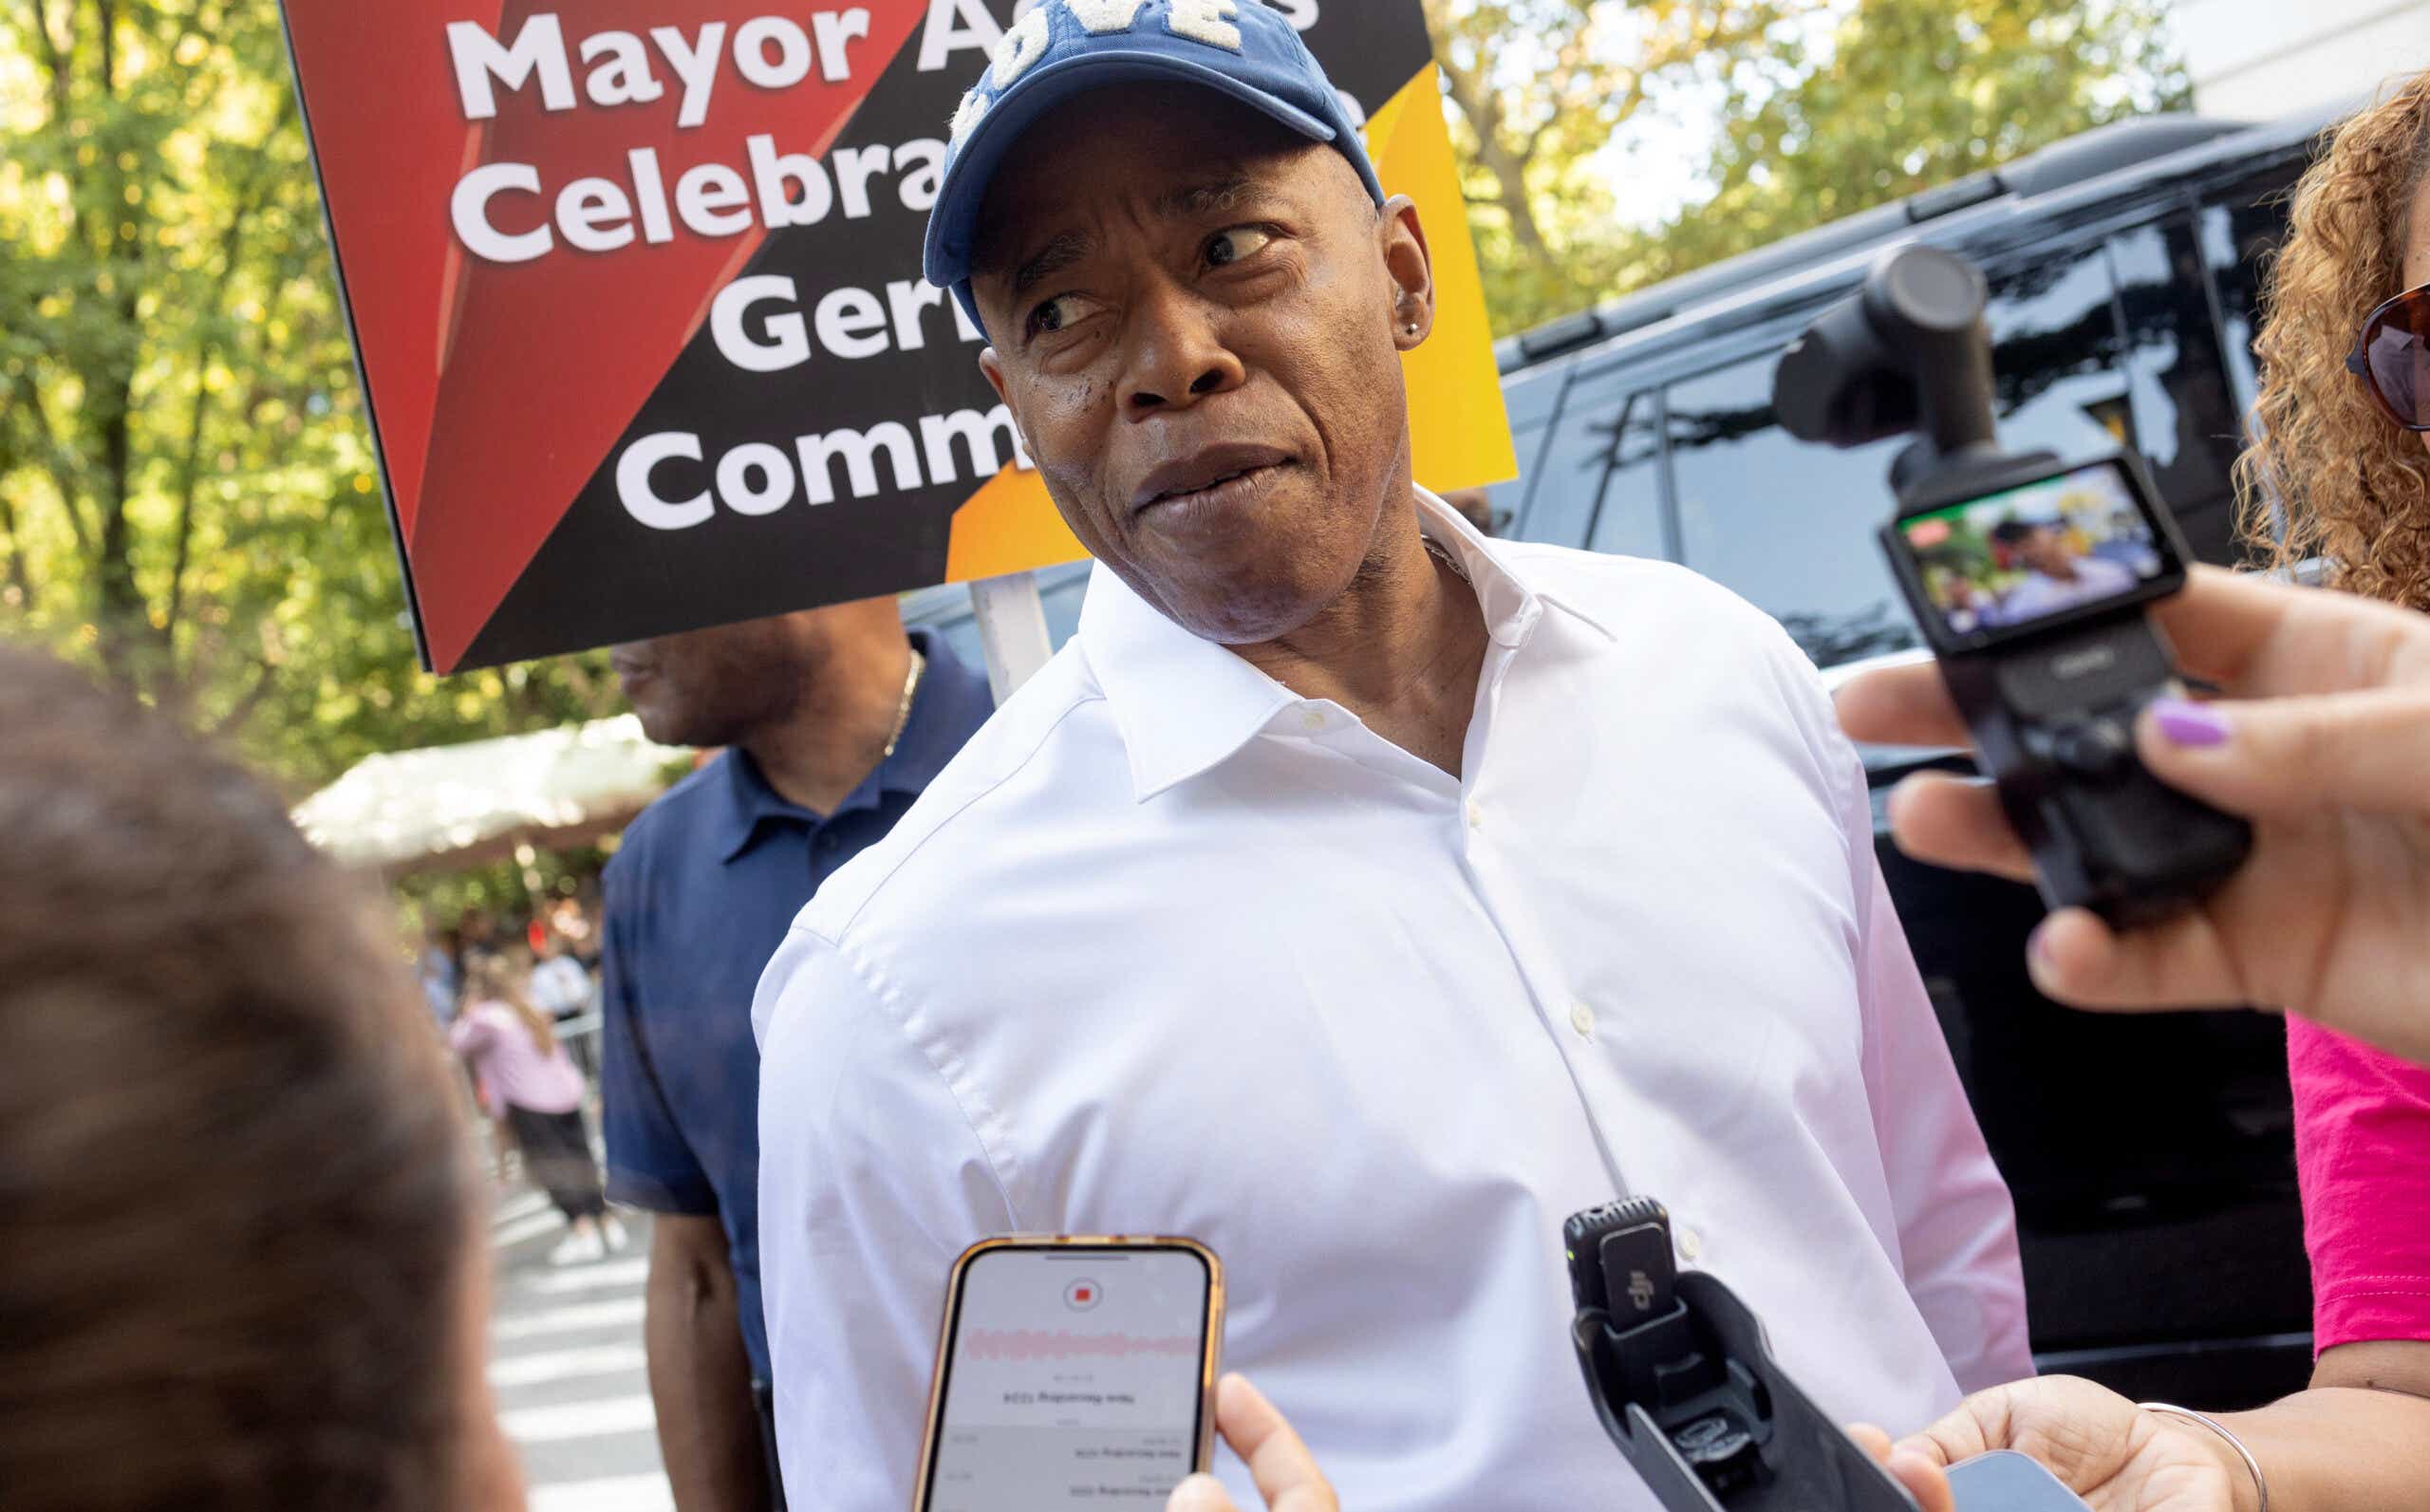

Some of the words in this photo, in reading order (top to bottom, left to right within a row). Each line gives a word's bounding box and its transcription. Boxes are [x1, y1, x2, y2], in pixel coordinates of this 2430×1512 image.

[445, 7, 871, 128] Mayor
[450, 134, 946, 264] Celebra
[710, 274, 987, 372] Ger
[615, 402, 1035, 531] Comm
